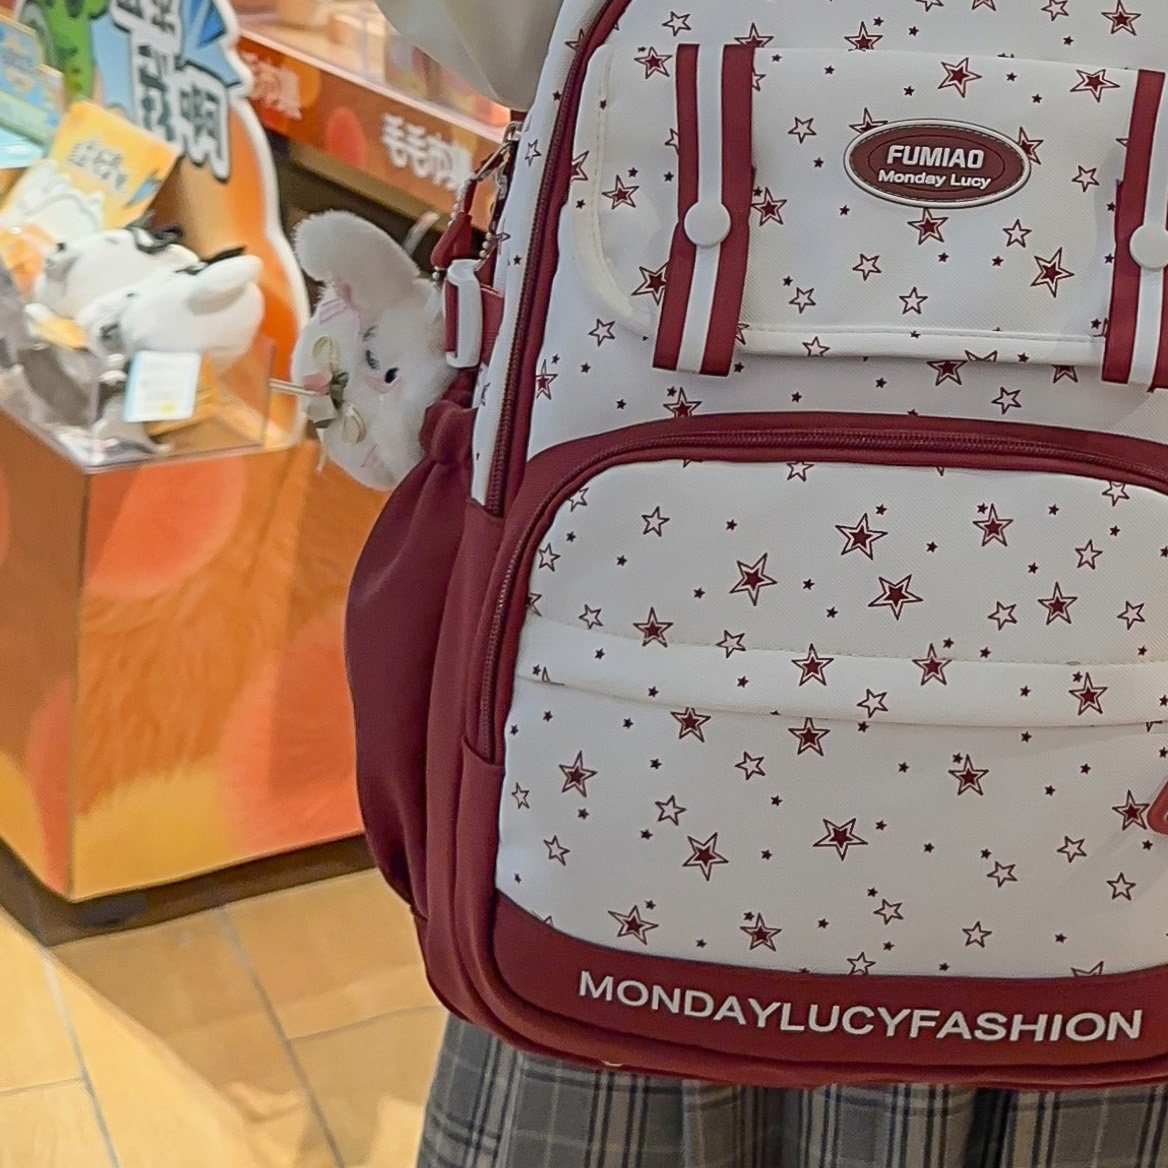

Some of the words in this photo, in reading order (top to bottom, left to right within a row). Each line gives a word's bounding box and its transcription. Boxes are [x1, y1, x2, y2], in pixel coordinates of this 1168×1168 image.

[886, 144, 985, 170] FUMIAO
[878, 169, 946, 188] Monday
[951, 173, 992, 190] Lucy
[578, 969, 1143, 1042] MONDAYLUCYFASHION
